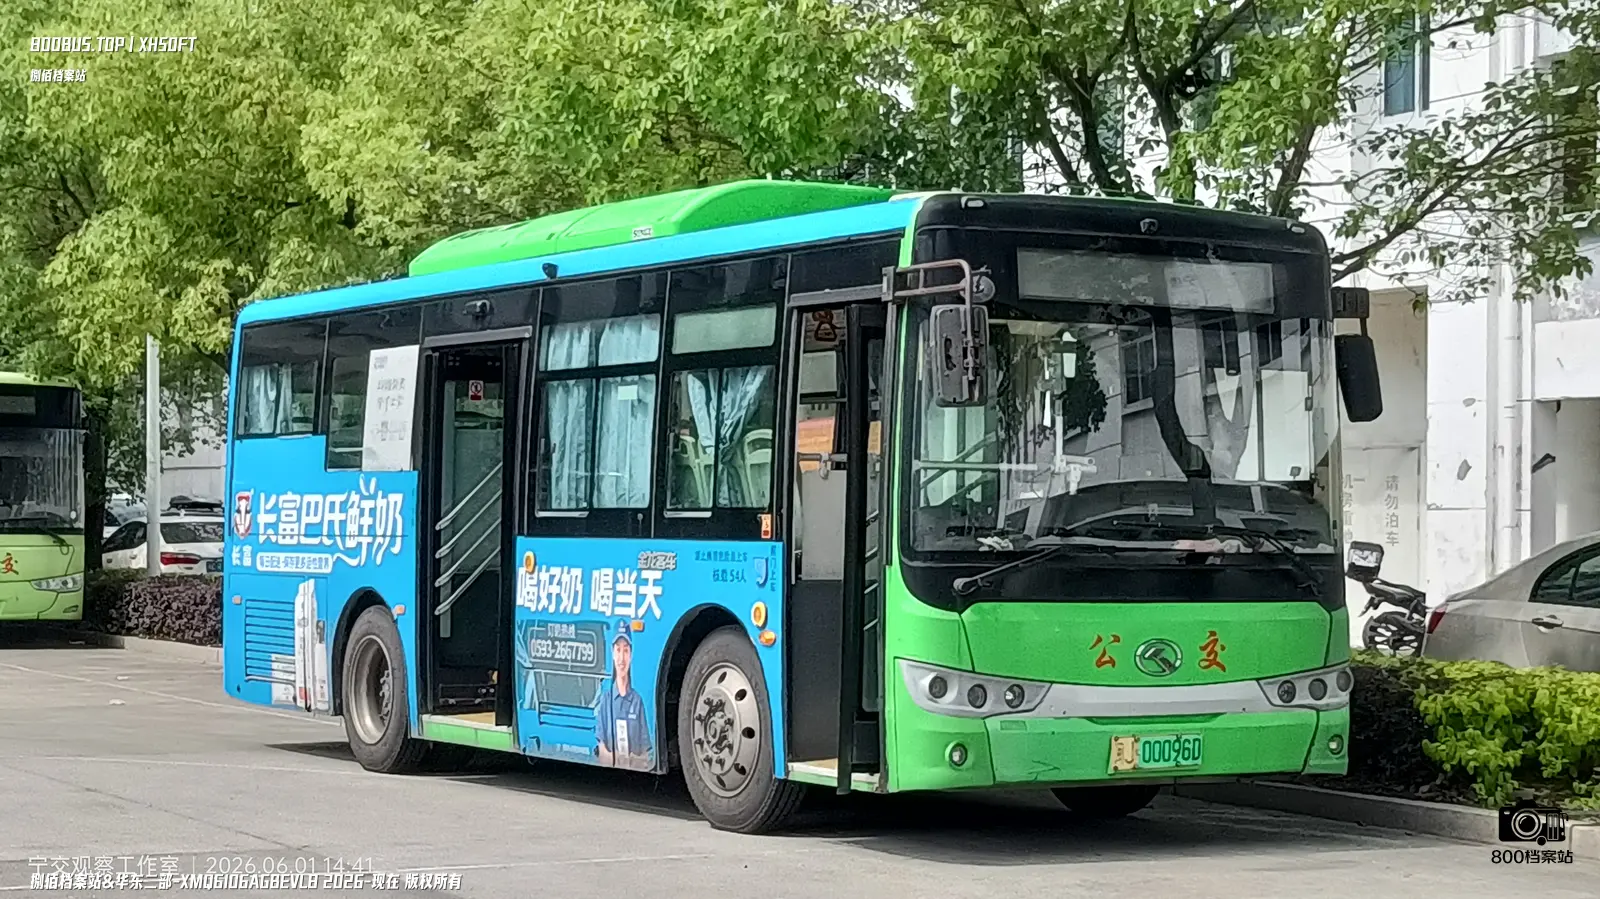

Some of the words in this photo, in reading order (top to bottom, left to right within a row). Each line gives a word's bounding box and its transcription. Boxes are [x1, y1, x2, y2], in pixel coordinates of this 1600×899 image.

[257, 475, 404, 566] 长富巴氏鲜奶
[1384, 475, 1399, 546] 请勿泊车
[232, 545, 252, 567] 长富
[516, 565, 583, 614] 喝好奶
[590, 568, 663, 620] 喝当天
[530, 638, 594, 661] 0593-2667799
[1089, 634, 1121, 669] 公
[1198, 630, 1226, 672] 交
